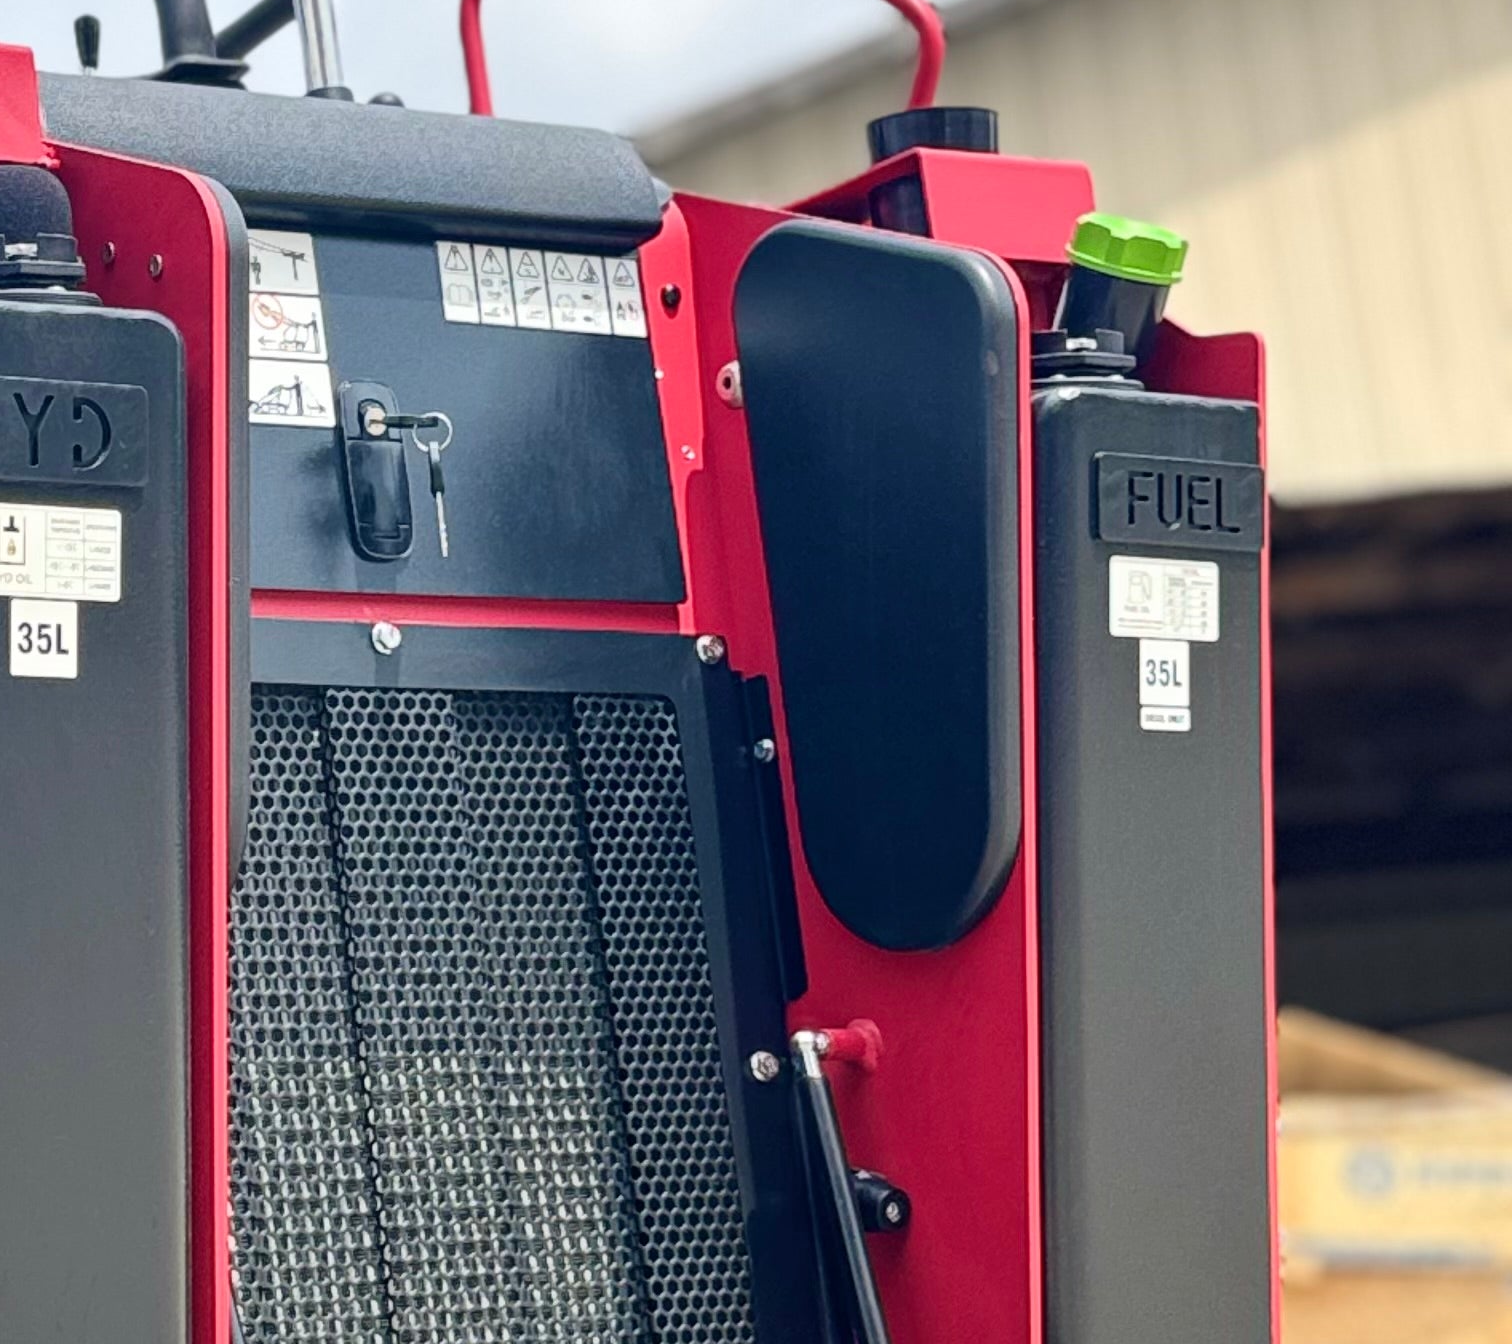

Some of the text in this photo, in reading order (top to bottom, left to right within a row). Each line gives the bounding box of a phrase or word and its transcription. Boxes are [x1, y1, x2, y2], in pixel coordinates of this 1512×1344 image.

[1127, 471, 1241, 533] FUEL
[18, 622, 69, 655] 35L
[1145, 659, 1183, 687] 35L
